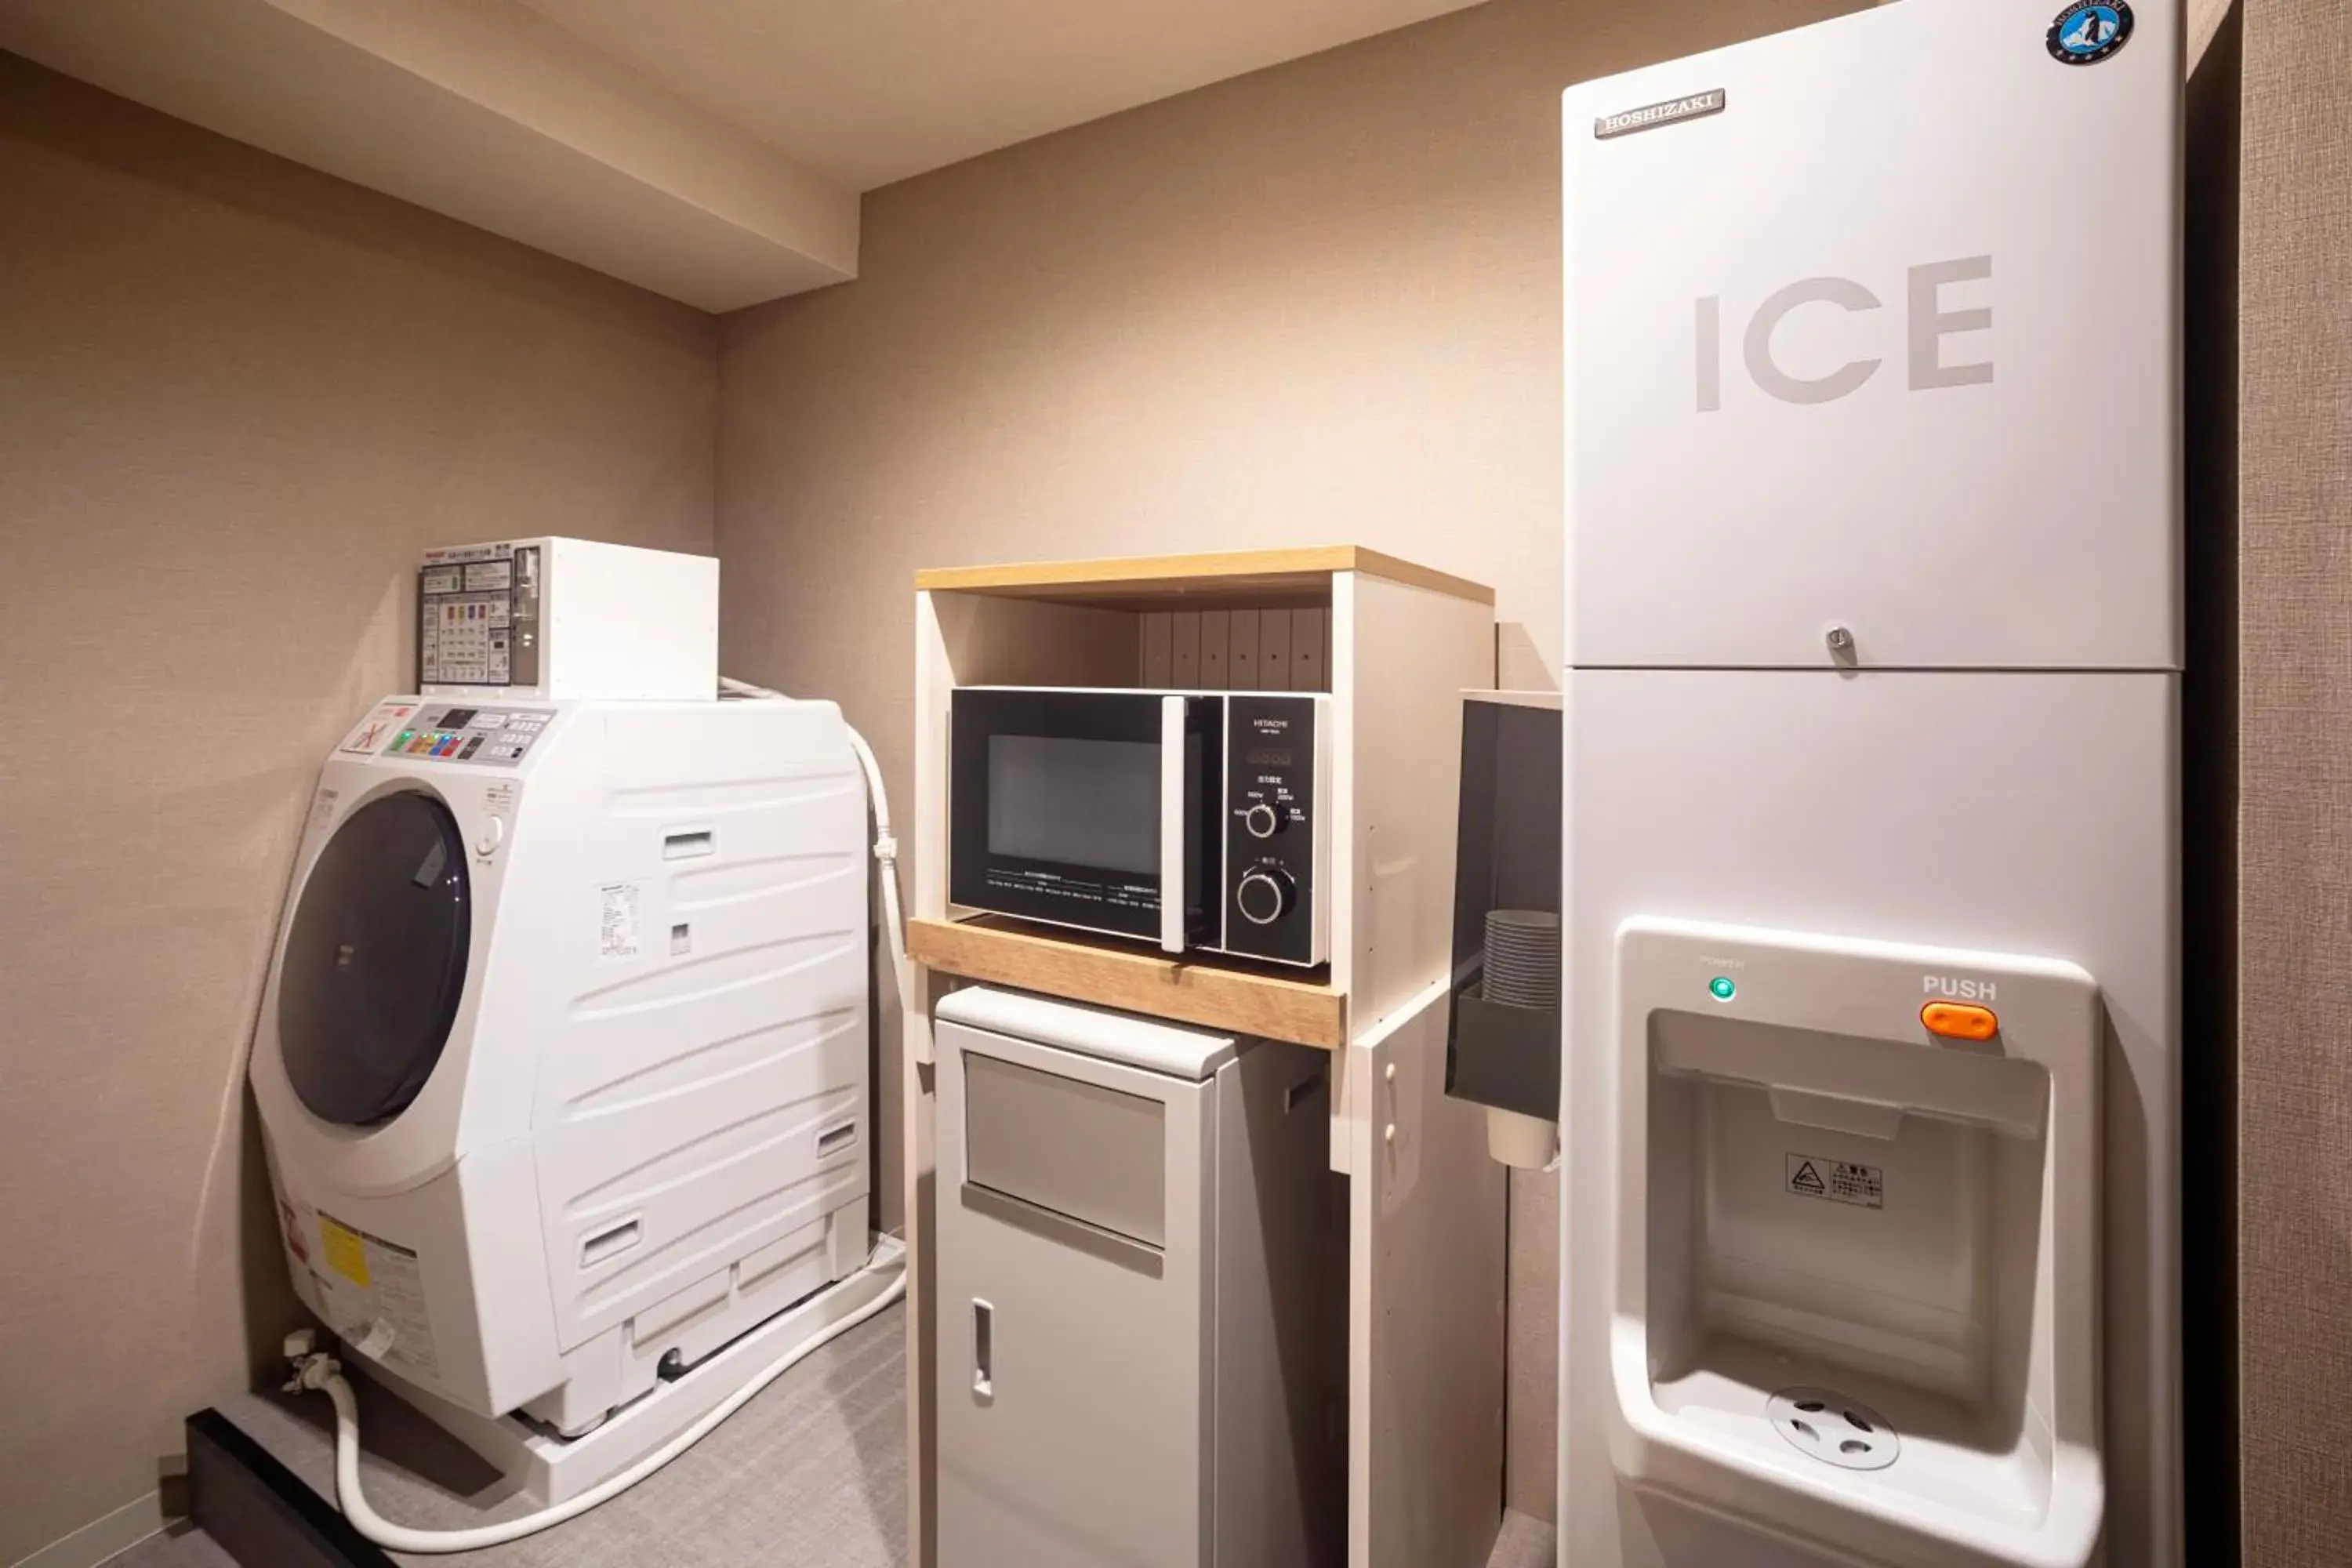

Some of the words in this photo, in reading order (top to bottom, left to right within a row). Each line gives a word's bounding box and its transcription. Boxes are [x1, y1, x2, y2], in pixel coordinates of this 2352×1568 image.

[1605, 94, 1715, 130] HOSHIZAKI
[1695, 255, 1994, 413] ICE
[1254, 719, 1288, 728] HITACHI
[1700, 955, 1745, 971] POWER
[1923, 975, 1997, 1001] PUSH
